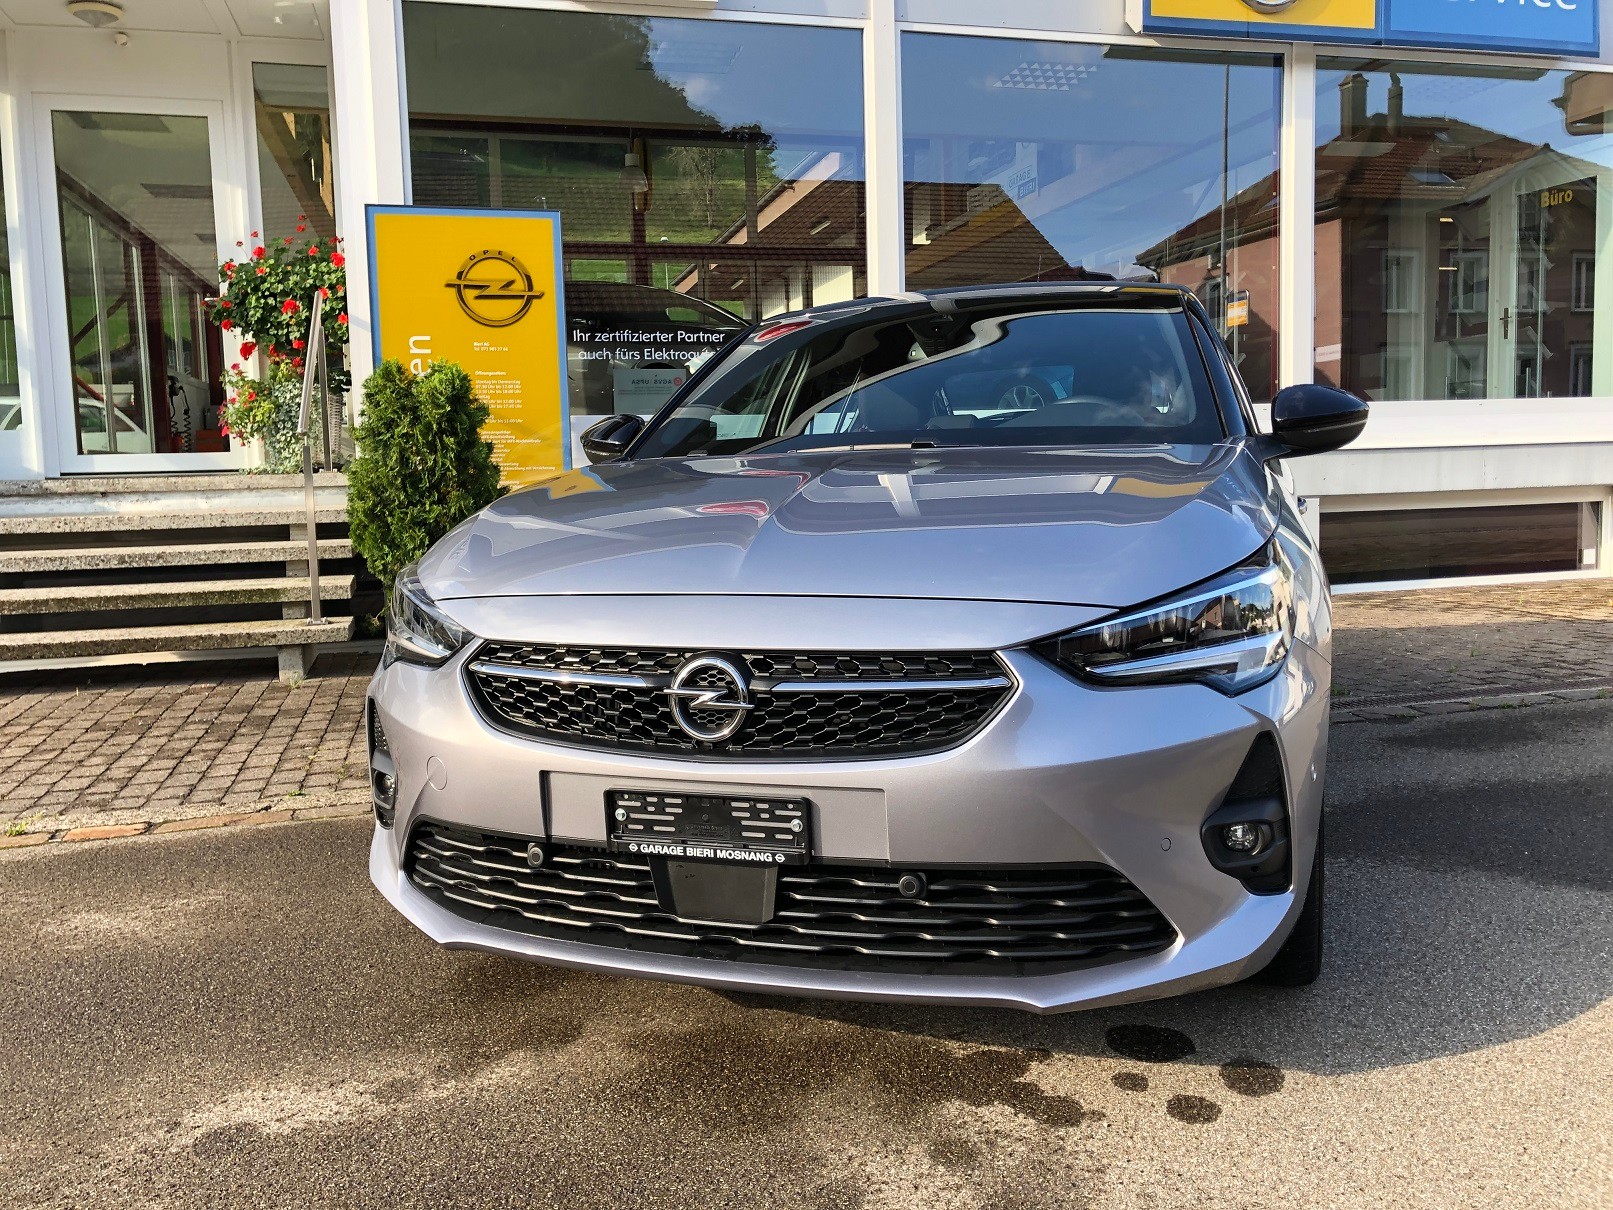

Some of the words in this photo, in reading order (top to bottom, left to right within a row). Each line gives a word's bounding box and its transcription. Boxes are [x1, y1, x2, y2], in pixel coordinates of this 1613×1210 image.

[1540, 189, 1573, 208] Büro
[469, 249, 516, 262] OPEL
[573, 329, 591, 342] Ihr
[594, 329, 674, 342] zertifizierter
[677, 330, 726, 342] Partner
[578, 347, 612, 360] auch
[615, 347, 641, 360] fürs
[640, 844, 684, 856] GARAGE
[686, 846, 714, 858] BIERI
[716, 850, 773, 862] MOSNANG
